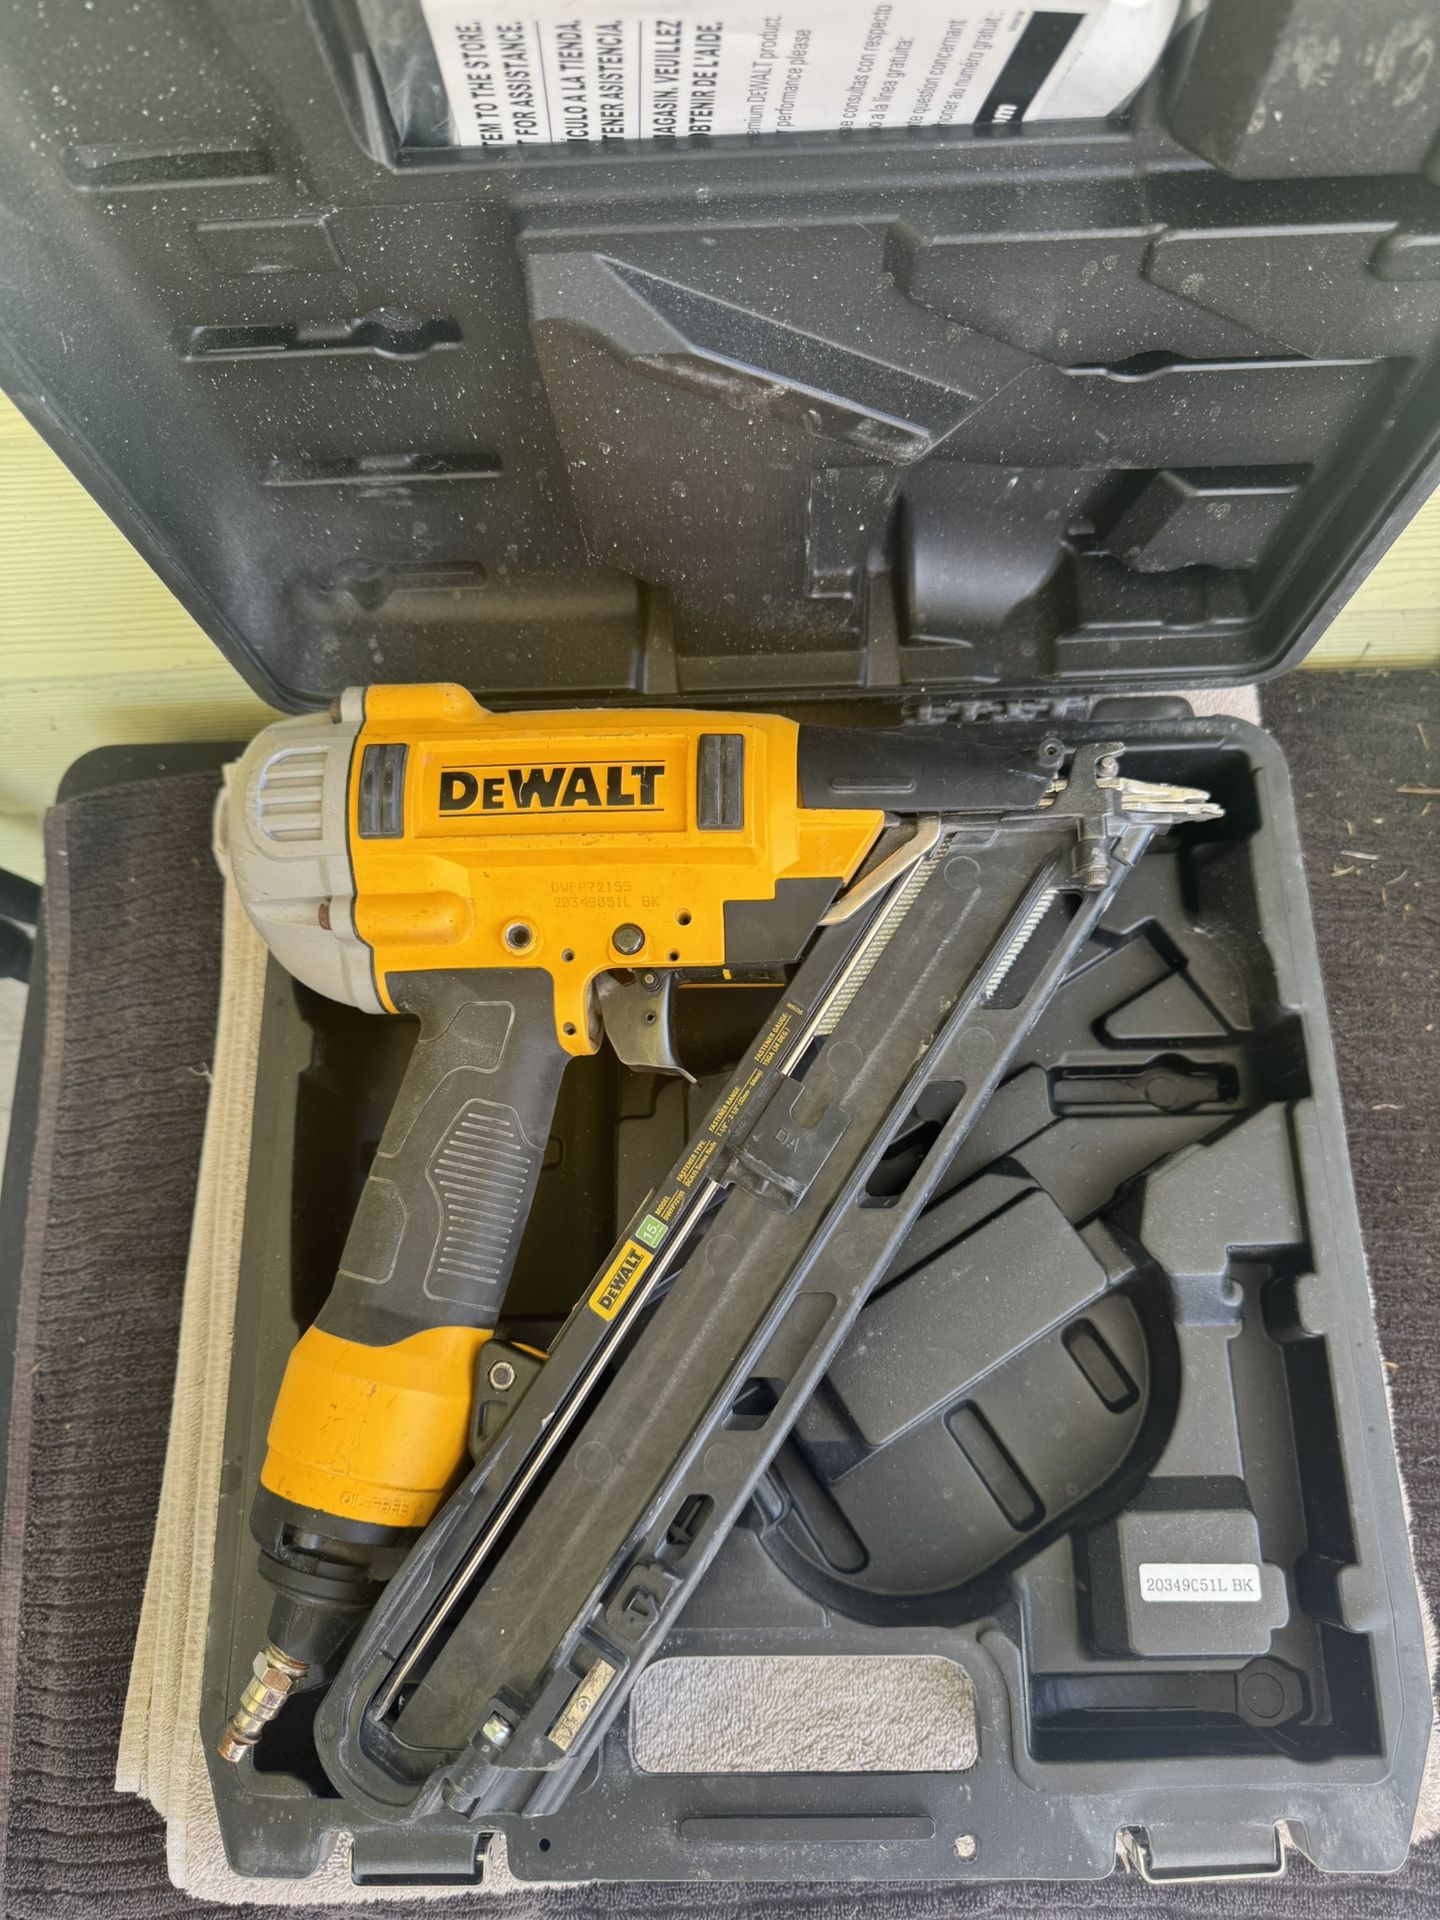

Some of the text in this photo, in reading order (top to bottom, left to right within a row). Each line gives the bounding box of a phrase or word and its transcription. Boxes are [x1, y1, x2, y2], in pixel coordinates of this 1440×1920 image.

[455, 21, 490, 69] STORE.
[555, 20, 585, 71] TIENDA.
[693, 22, 723, 67] L'AIDE.
[757, 15, 782, 59] product.
[863, 5, 893, 51] respecto
[496, 21, 535, 107] ASSISTANCE.
[596, 20, 625, 100] ASISTENCIA.
[787, 30, 812, 66] please
[857, 54, 876, 72] con
[912, 78, 939, 114] question
[930, 19, 967, 76] concernant
[467, 73, 496, 98] THE
[561, 76, 586, 91] LA
[652, 20, 682, 138] AGASIN. VEUILLEZ
[692, 72, 718, 87] DE
[871, 80, 898, 102] línea
[886, 38, 915, 78] gratuita:
[955, 53, 984, 86] numéro
[473, 103, 500, 119] TO
[775, 67, 803, 127] performance
[842, 75, 870, 119] consultas
[948, 88, 965, 99] au
[512, 111, 538, 135] FOR
[642, 895, 660, 908] BK
[754, 1012, 789, 1062] FASTENER GAUGE:
[708, 1104, 729, 1132] FASTENER
[676, 1139, 707, 1181] FASTENER TYPE:
[695, 1154, 709, 1172] Series
[705, 1141, 717, 1156] Nails
[655, 1196, 671, 1216] MODEL
[1232, 1578, 1255, 1592] BK
